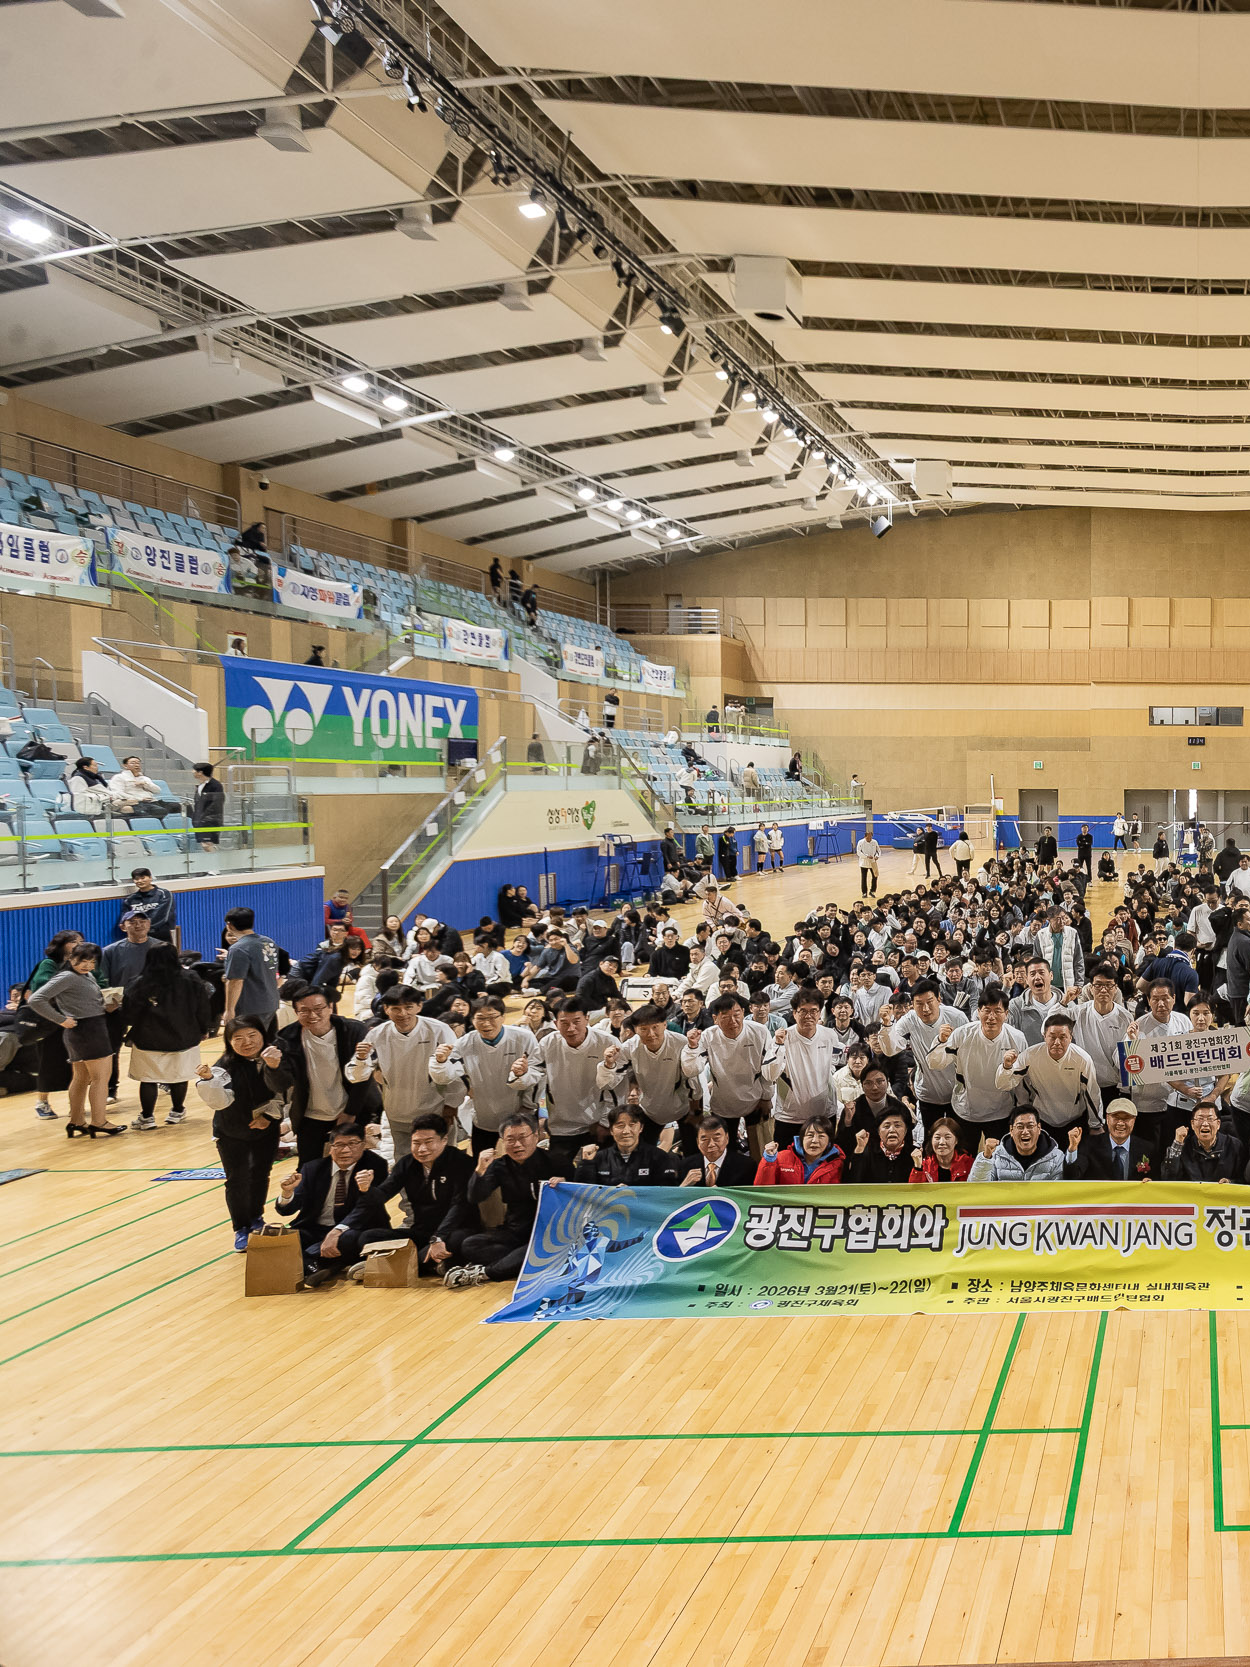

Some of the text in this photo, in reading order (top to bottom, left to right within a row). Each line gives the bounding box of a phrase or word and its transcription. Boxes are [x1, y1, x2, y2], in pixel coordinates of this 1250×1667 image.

[145, 545, 199, 575] 양진클럽
[341, 686, 468, 750] YONEX
[1150, 1034, 1239, 1054] 제31회 광진구협회장기
[1127, 1057, 1141, 1071] 필
[1150, 1046, 1242, 1069] 배드민턴대회
[744, 1206, 948, 1252] 광진구협회와
[714, 1283, 743, 1297] 일시
[757, 1285, 810, 1297] 2026년
[967, 1278, 993, 1292] 장소
[1010, 1280, 1140, 1292] 남양주체육문화센터내
[1146, 1282, 1210, 1292] 실내체육관
[705, 1300, 733, 1308] 주최
[776, 1298, 859, 1308] 광진구체육회
